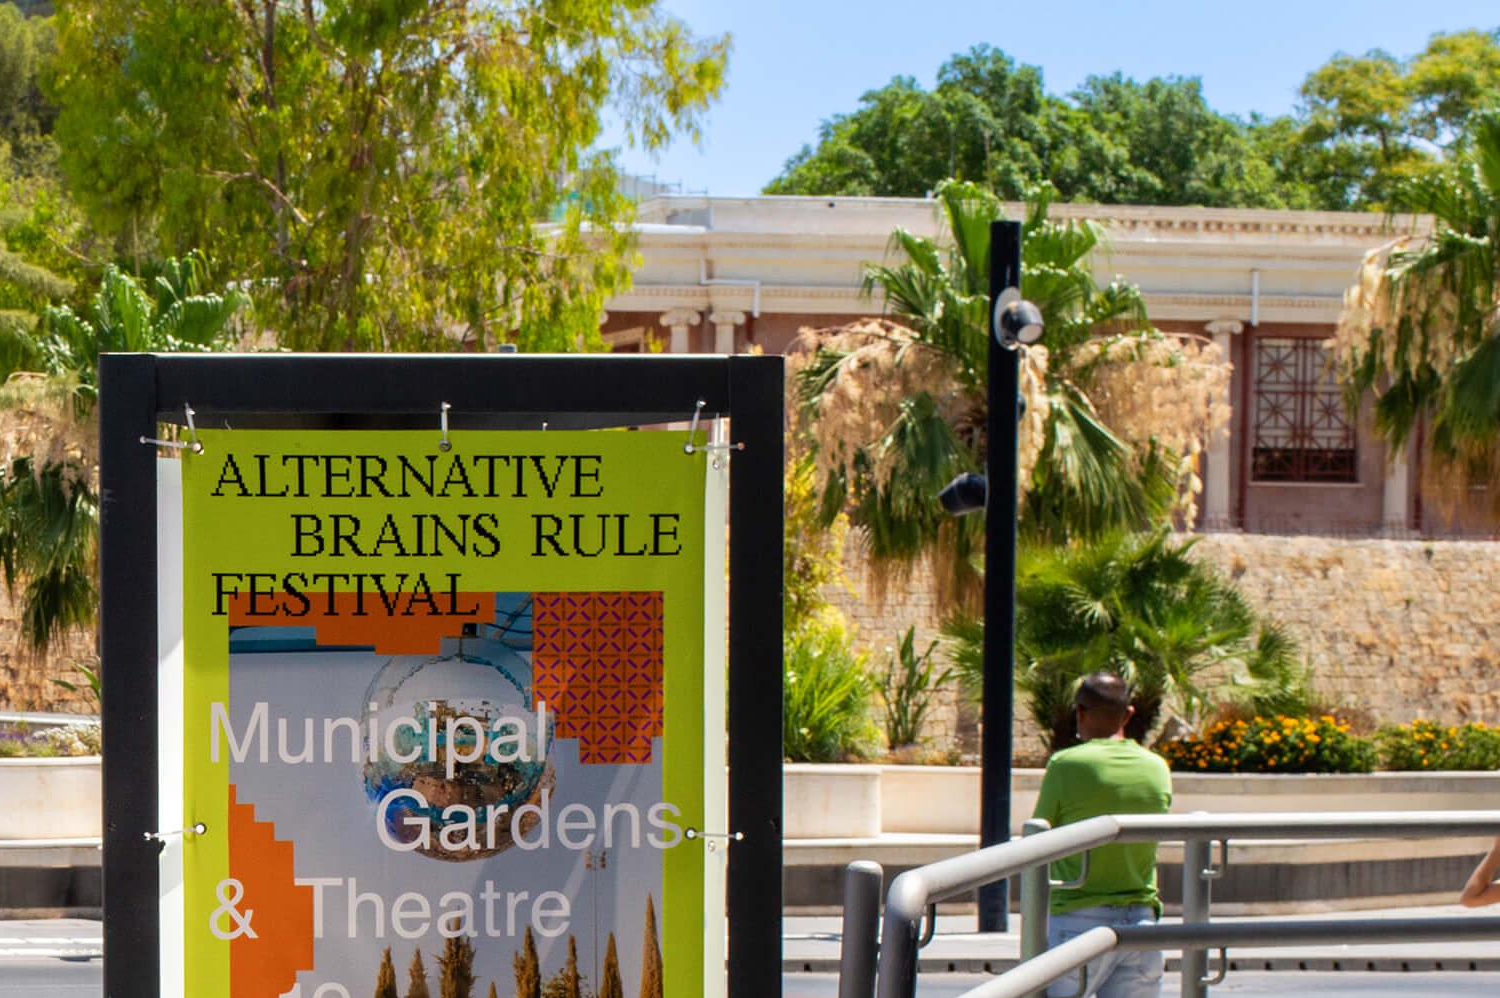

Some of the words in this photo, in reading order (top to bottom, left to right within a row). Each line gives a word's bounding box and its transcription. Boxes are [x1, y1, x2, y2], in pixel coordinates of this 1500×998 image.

[211, 454, 603, 498] ALTERNATIVE
[291, 514, 500, 557] BRAINS
[531, 513, 682, 557] RULE
[211, 573, 479, 617] FESTIVAL
[211, 701, 546, 779] Municipal
[377, 789, 682, 851] Gardens
[209, 878, 257, 941] &
[294, 876, 570, 940] Theatre
